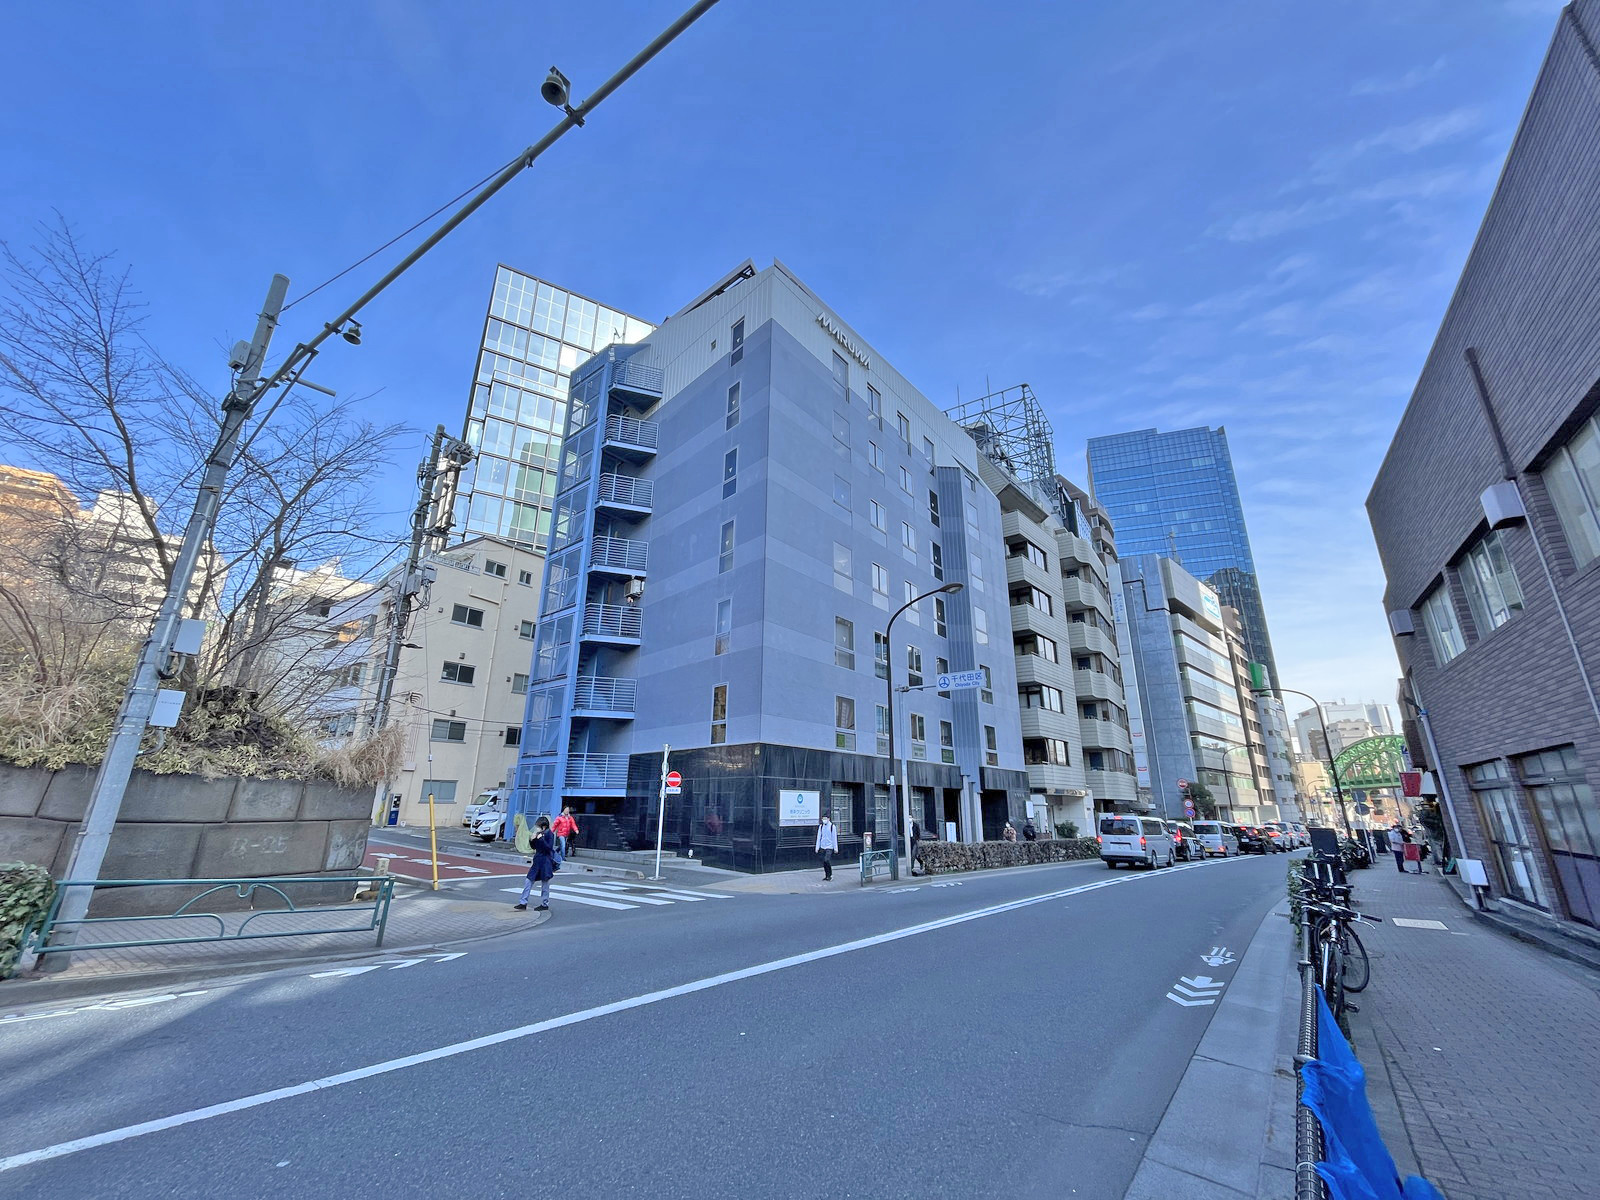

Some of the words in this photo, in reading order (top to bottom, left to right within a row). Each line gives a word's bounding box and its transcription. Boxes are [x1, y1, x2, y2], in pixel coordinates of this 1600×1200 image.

[818, 312, 871, 370] MARUWA
[951, 672, 982, 682] 千代田区
